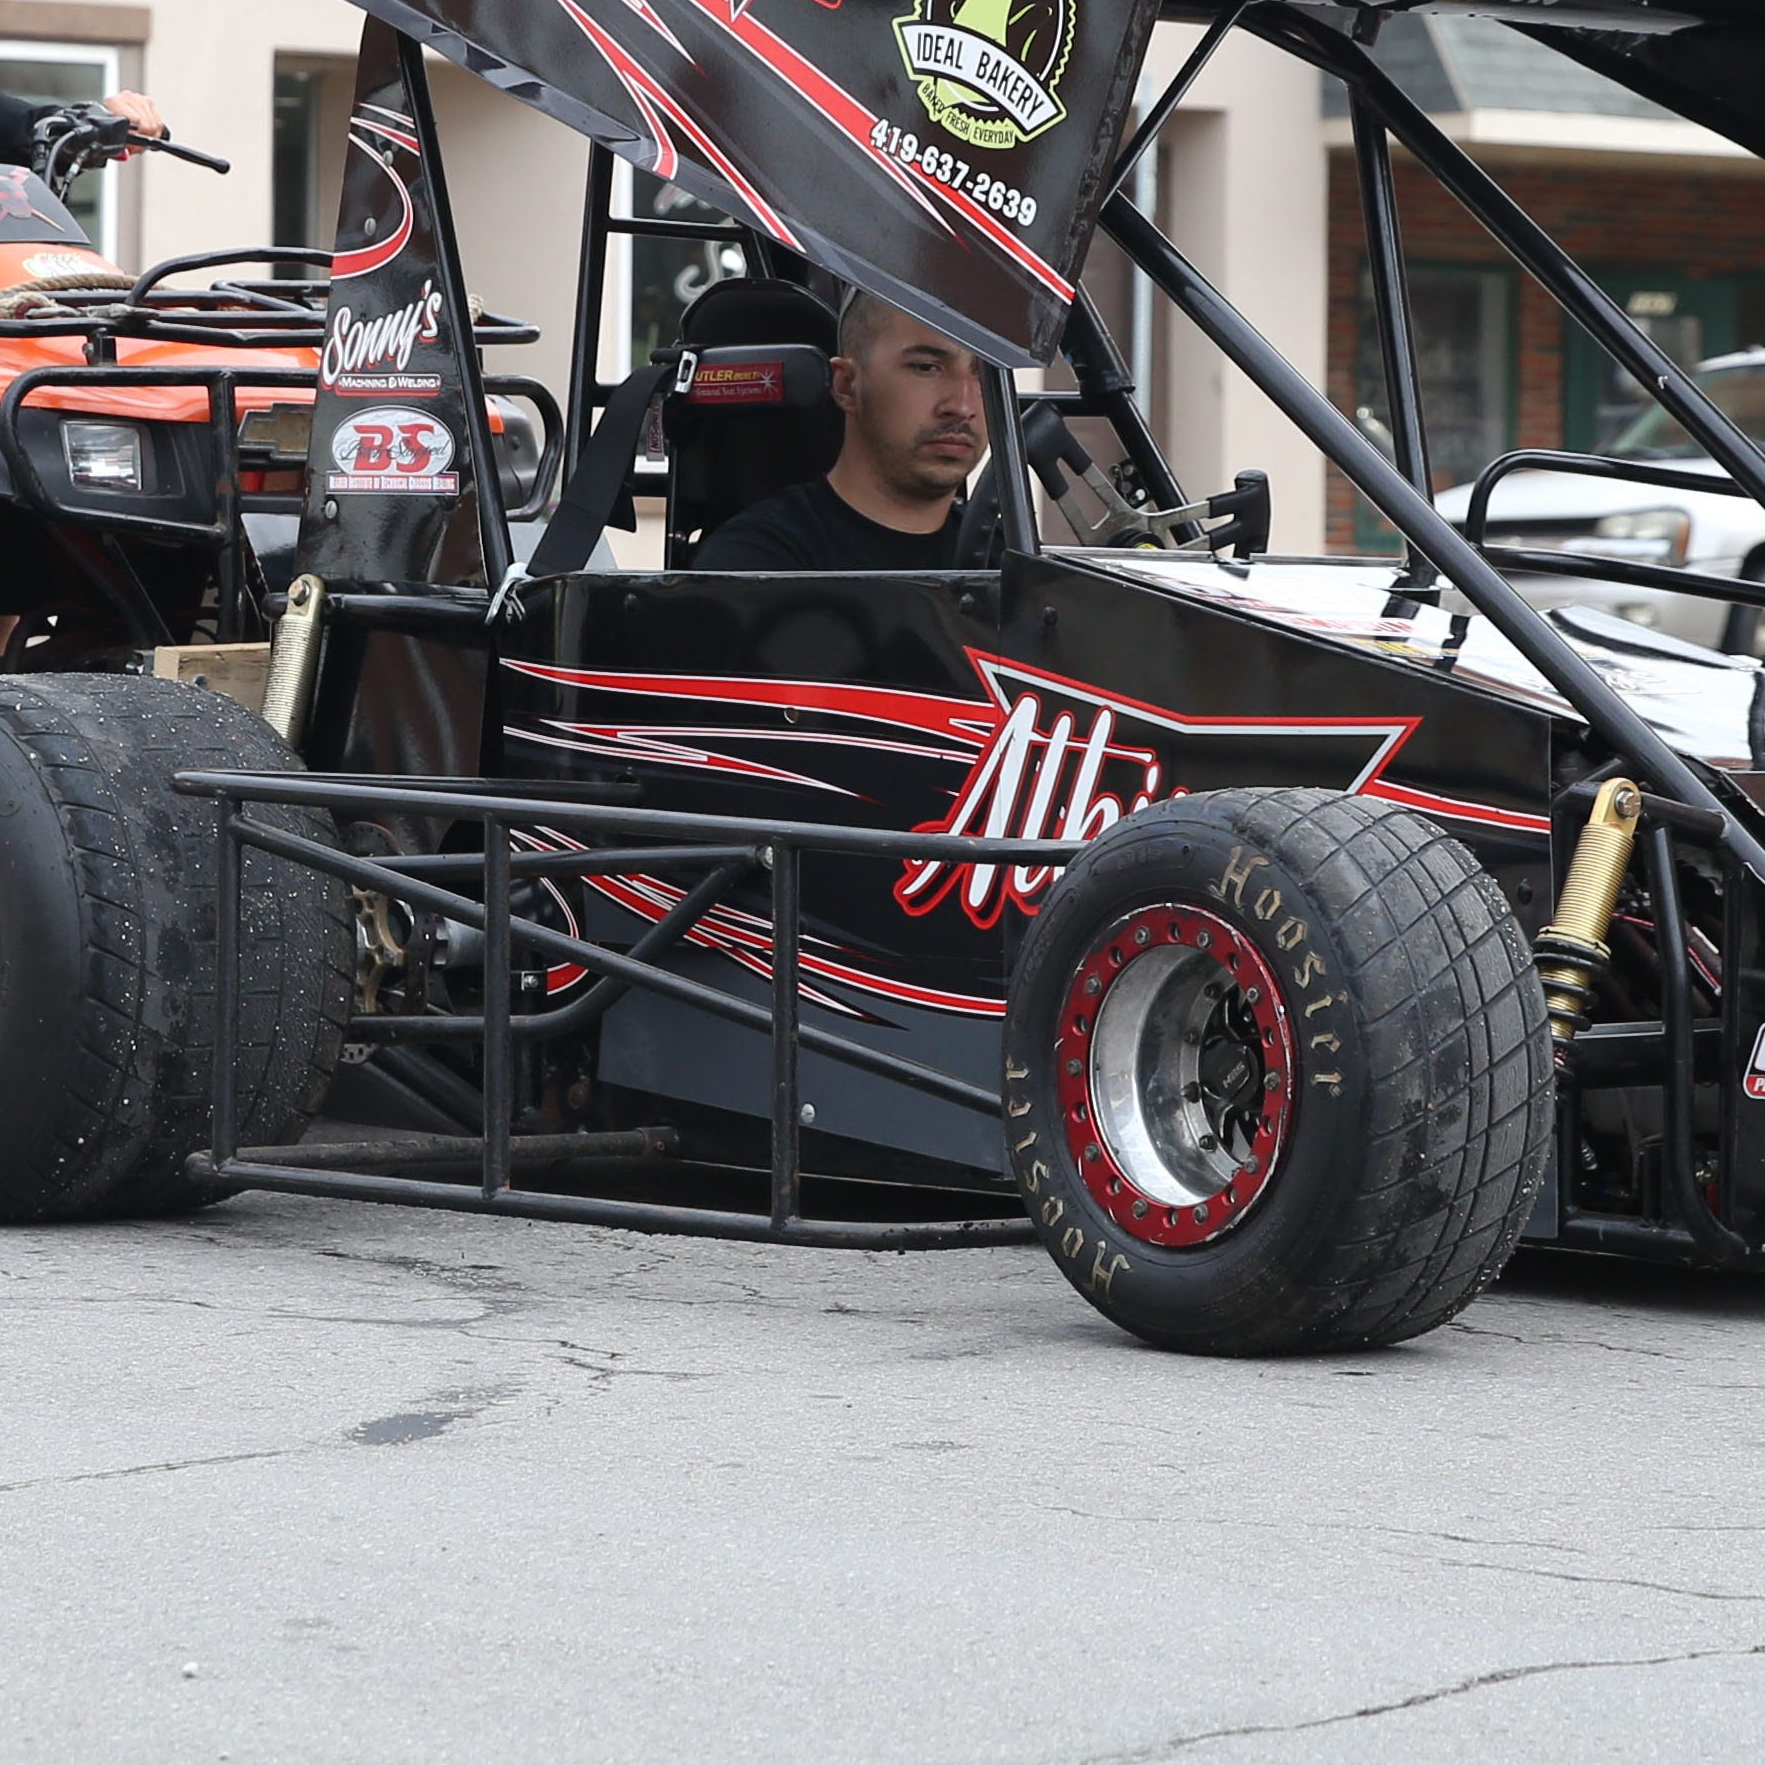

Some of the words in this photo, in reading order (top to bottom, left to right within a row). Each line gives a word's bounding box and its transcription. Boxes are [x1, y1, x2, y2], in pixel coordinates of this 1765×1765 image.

[917, 32, 963, 70] IDEAL
[975, 51, 1045, 120] BAKERY
[945, 111, 970, 133] FRESH
[973, 126, 1016, 144] EVERYDAY
[871, 118, 1037, 227] 419-637-2639
[323, 279, 442, 385] Sonny's
[353, 423, 435, 473] BS
